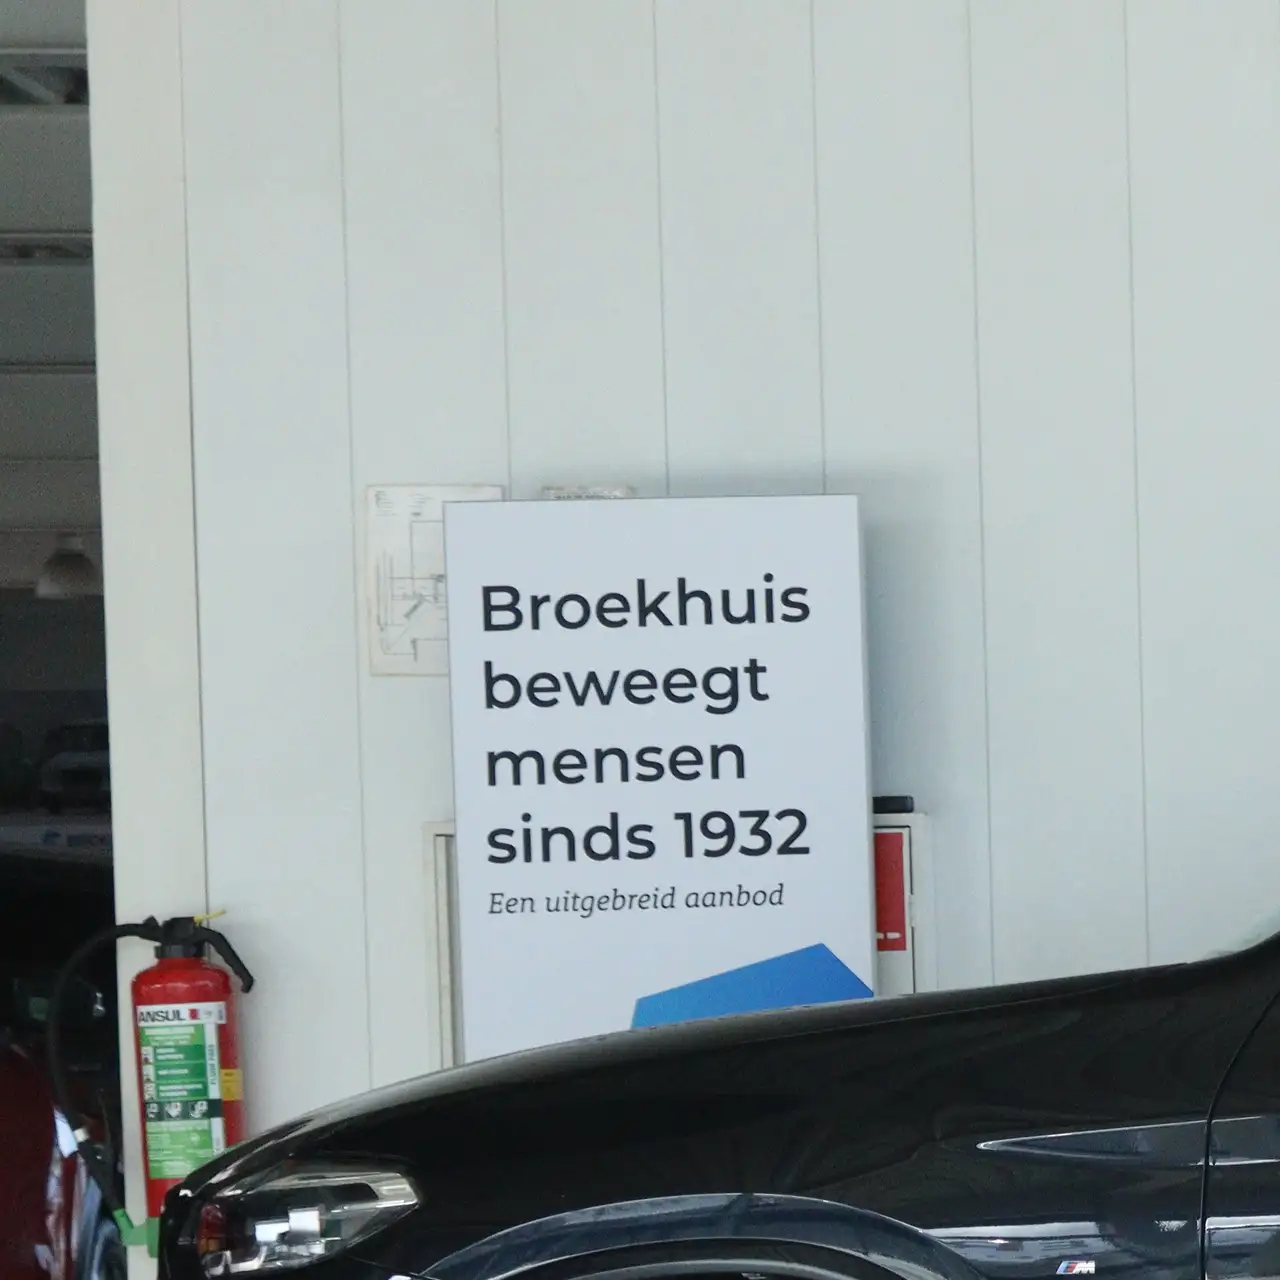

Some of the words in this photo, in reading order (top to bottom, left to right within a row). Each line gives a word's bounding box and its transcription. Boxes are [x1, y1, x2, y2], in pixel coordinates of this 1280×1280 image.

[482, 573, 811, 632] Broekhuis
[484, 658, 770, 716] beweegt
[487, 743, 746, 787] mensen
[487, 812, 656, 864] sinds
[674, 808, 811, 859] 1932
[488, 892, 536, 915] Een
[545, 887, 676, 919] uitgebreid
[685, 882, 784, 909] aanbod
[139, 1009, 186, 1023] ANSUL
